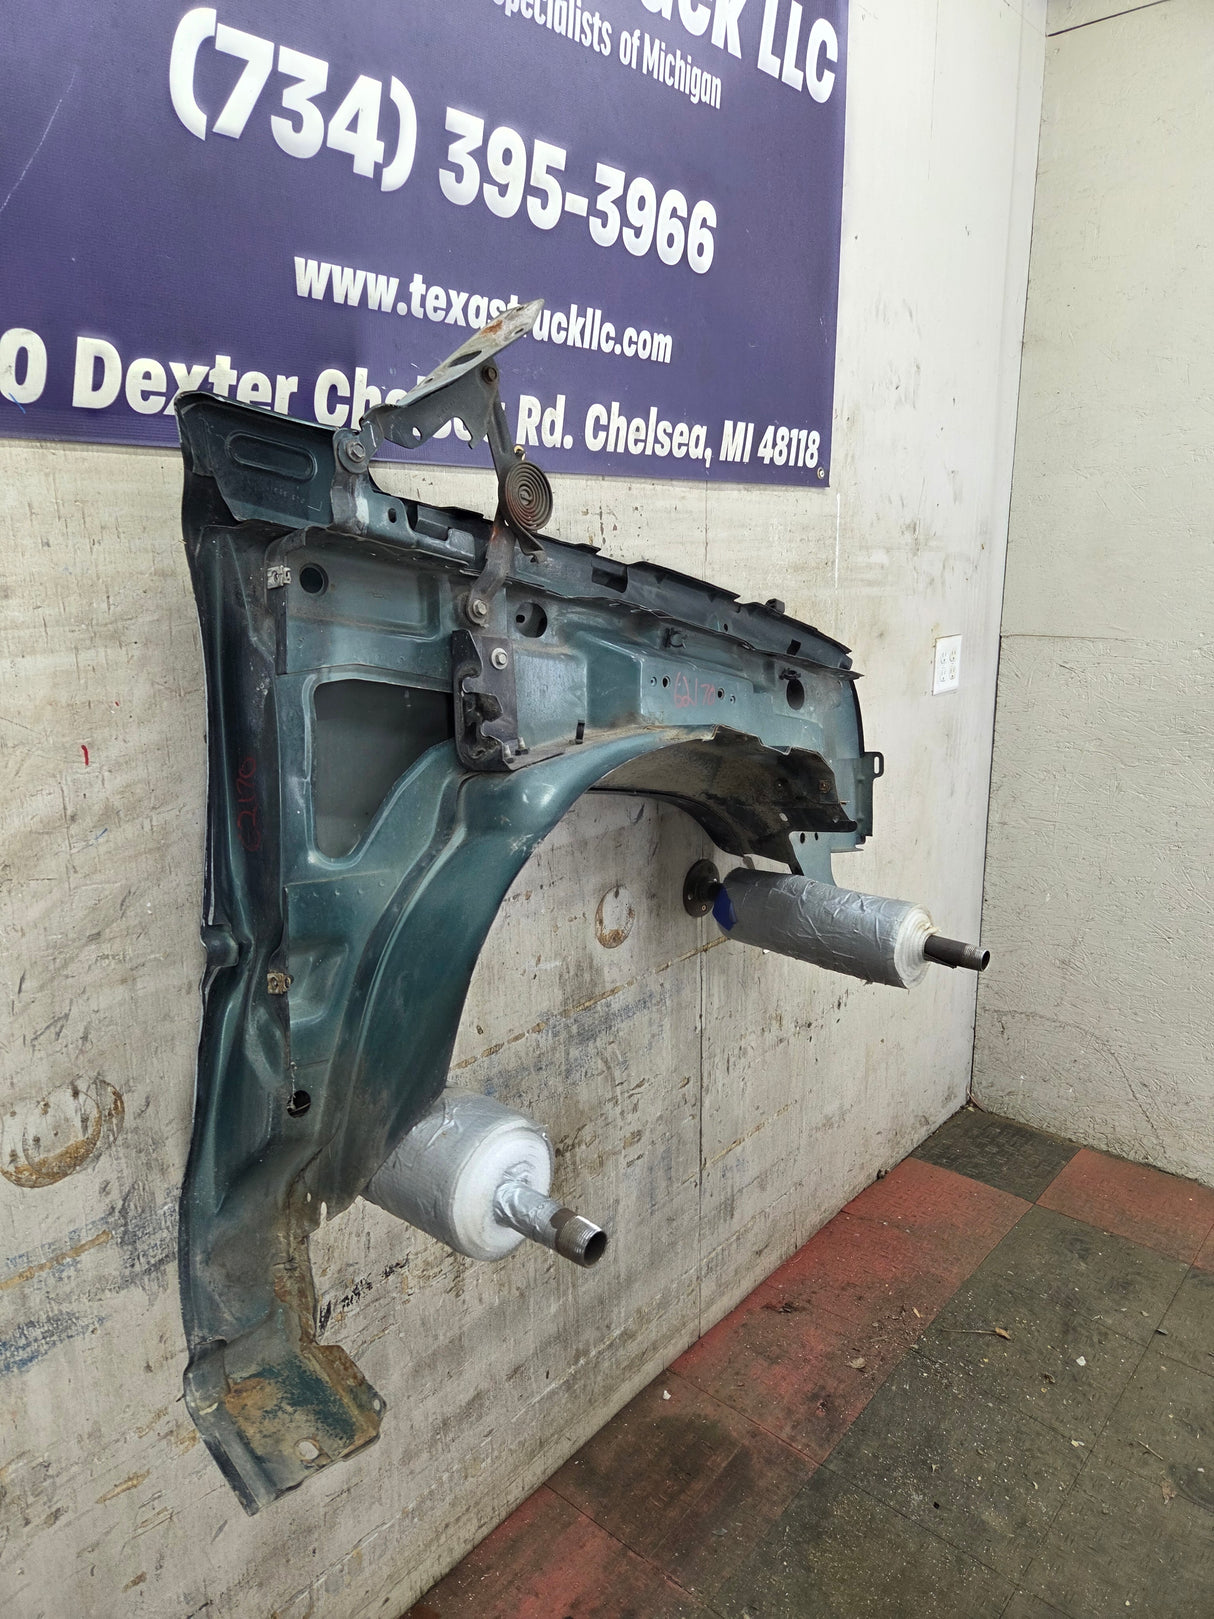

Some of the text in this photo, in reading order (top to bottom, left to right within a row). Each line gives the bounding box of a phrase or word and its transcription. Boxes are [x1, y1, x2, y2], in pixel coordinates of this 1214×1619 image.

[620, 29, 641, 69] of
[642, 33, 721, 109] Michigan
[757, 0, 839, 103] LLC
[169, 6, 717, 274] (734) 395-3966
[293, 256, 673, 363] www.texasuckllc.com
[73, 336, 299, 416] Dexter
[516, 395, 573, 449] Rd.
[584, 402, 712, 468] Chelsea,
[719, 420, 754, 463] MI
[758, 426, 820, 468] 48118
